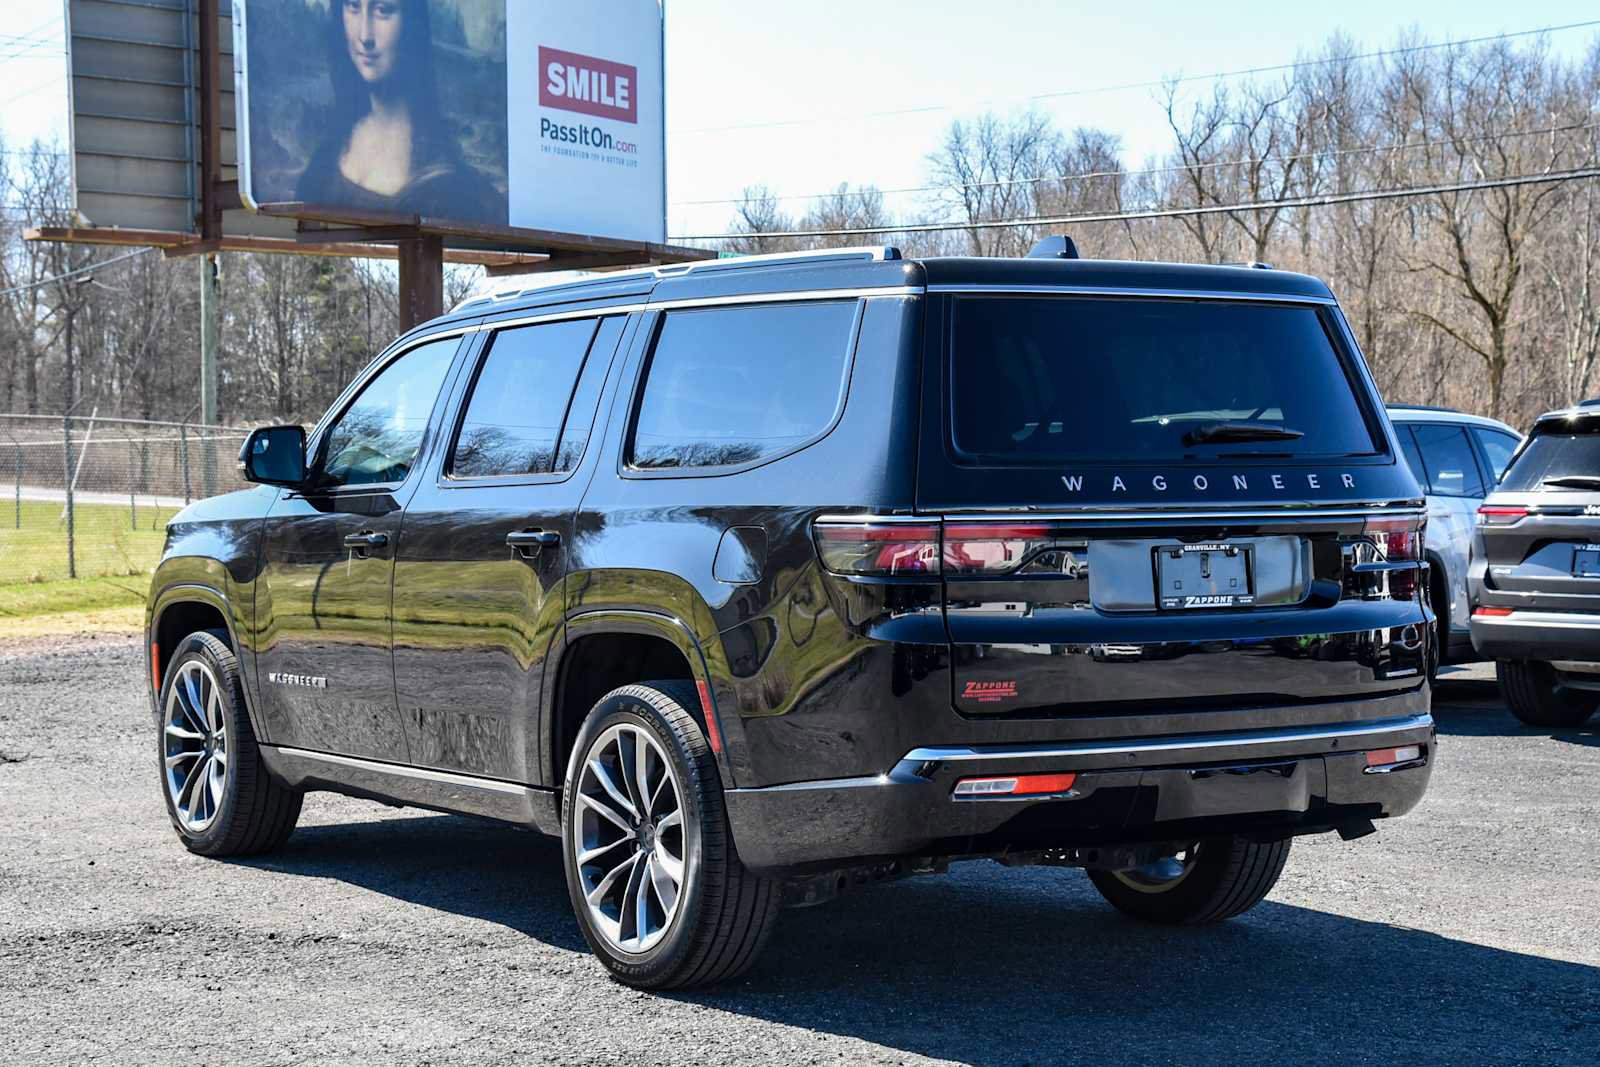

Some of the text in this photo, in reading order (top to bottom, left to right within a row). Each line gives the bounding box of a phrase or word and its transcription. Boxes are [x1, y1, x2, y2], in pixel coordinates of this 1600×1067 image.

[547, 62, 629, 109] SMILE
[541, 118, 637, 153] PassItOn.com
[1061, 473, 1355, 491] WAGONEER
[1184, 596, 1233, 608] ZAPPONE
[964, 681, 1016, 693] ZAPPONE
